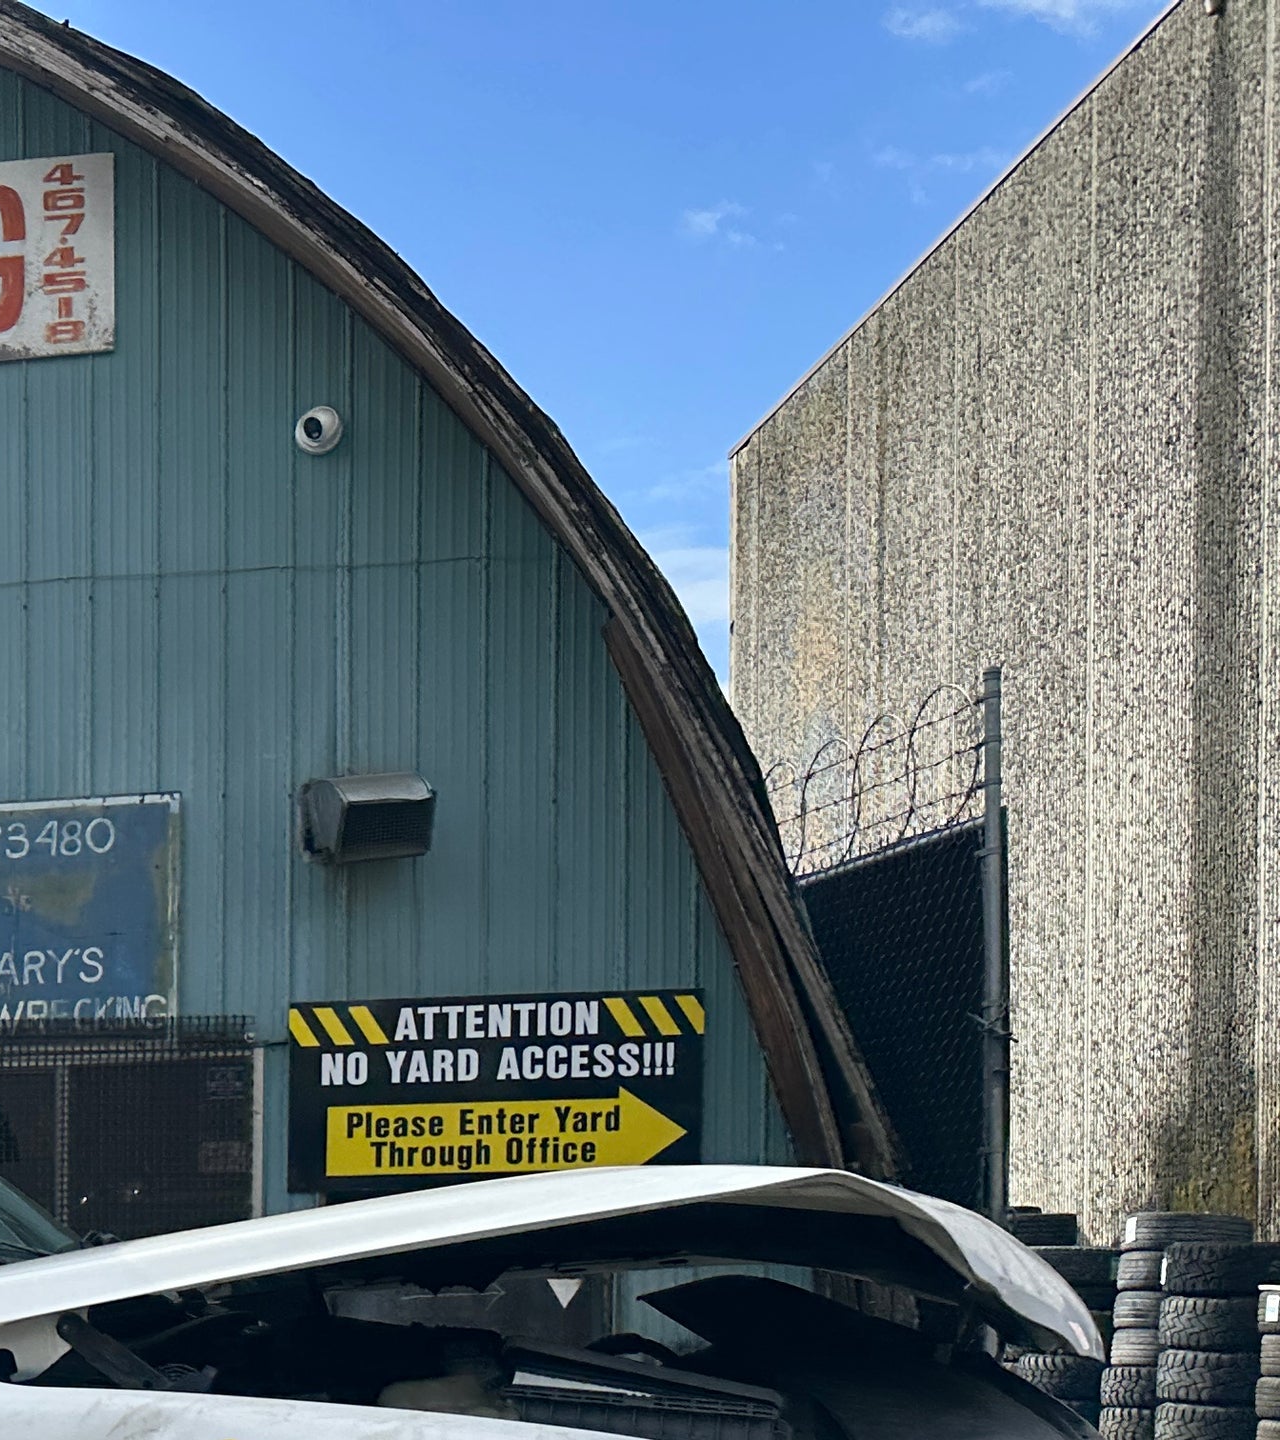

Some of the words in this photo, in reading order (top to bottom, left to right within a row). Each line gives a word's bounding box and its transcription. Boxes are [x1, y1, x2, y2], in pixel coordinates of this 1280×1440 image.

[394, 1000, 599, 1042] ATTENTION
[320, 1051, 369, 1086] NO
[385, 1047, 480, 1084] YARD
[496, 1042, 676, 1081] ACCESS!!!
[346, 1109, 444, 1139] Please
[459, 1107, 540, 1137] Enter
[554, 1105, 621, 1134] Yard
[370, 1138, 491, 1170] Through
[505, 1136, 597, 1165] Office
